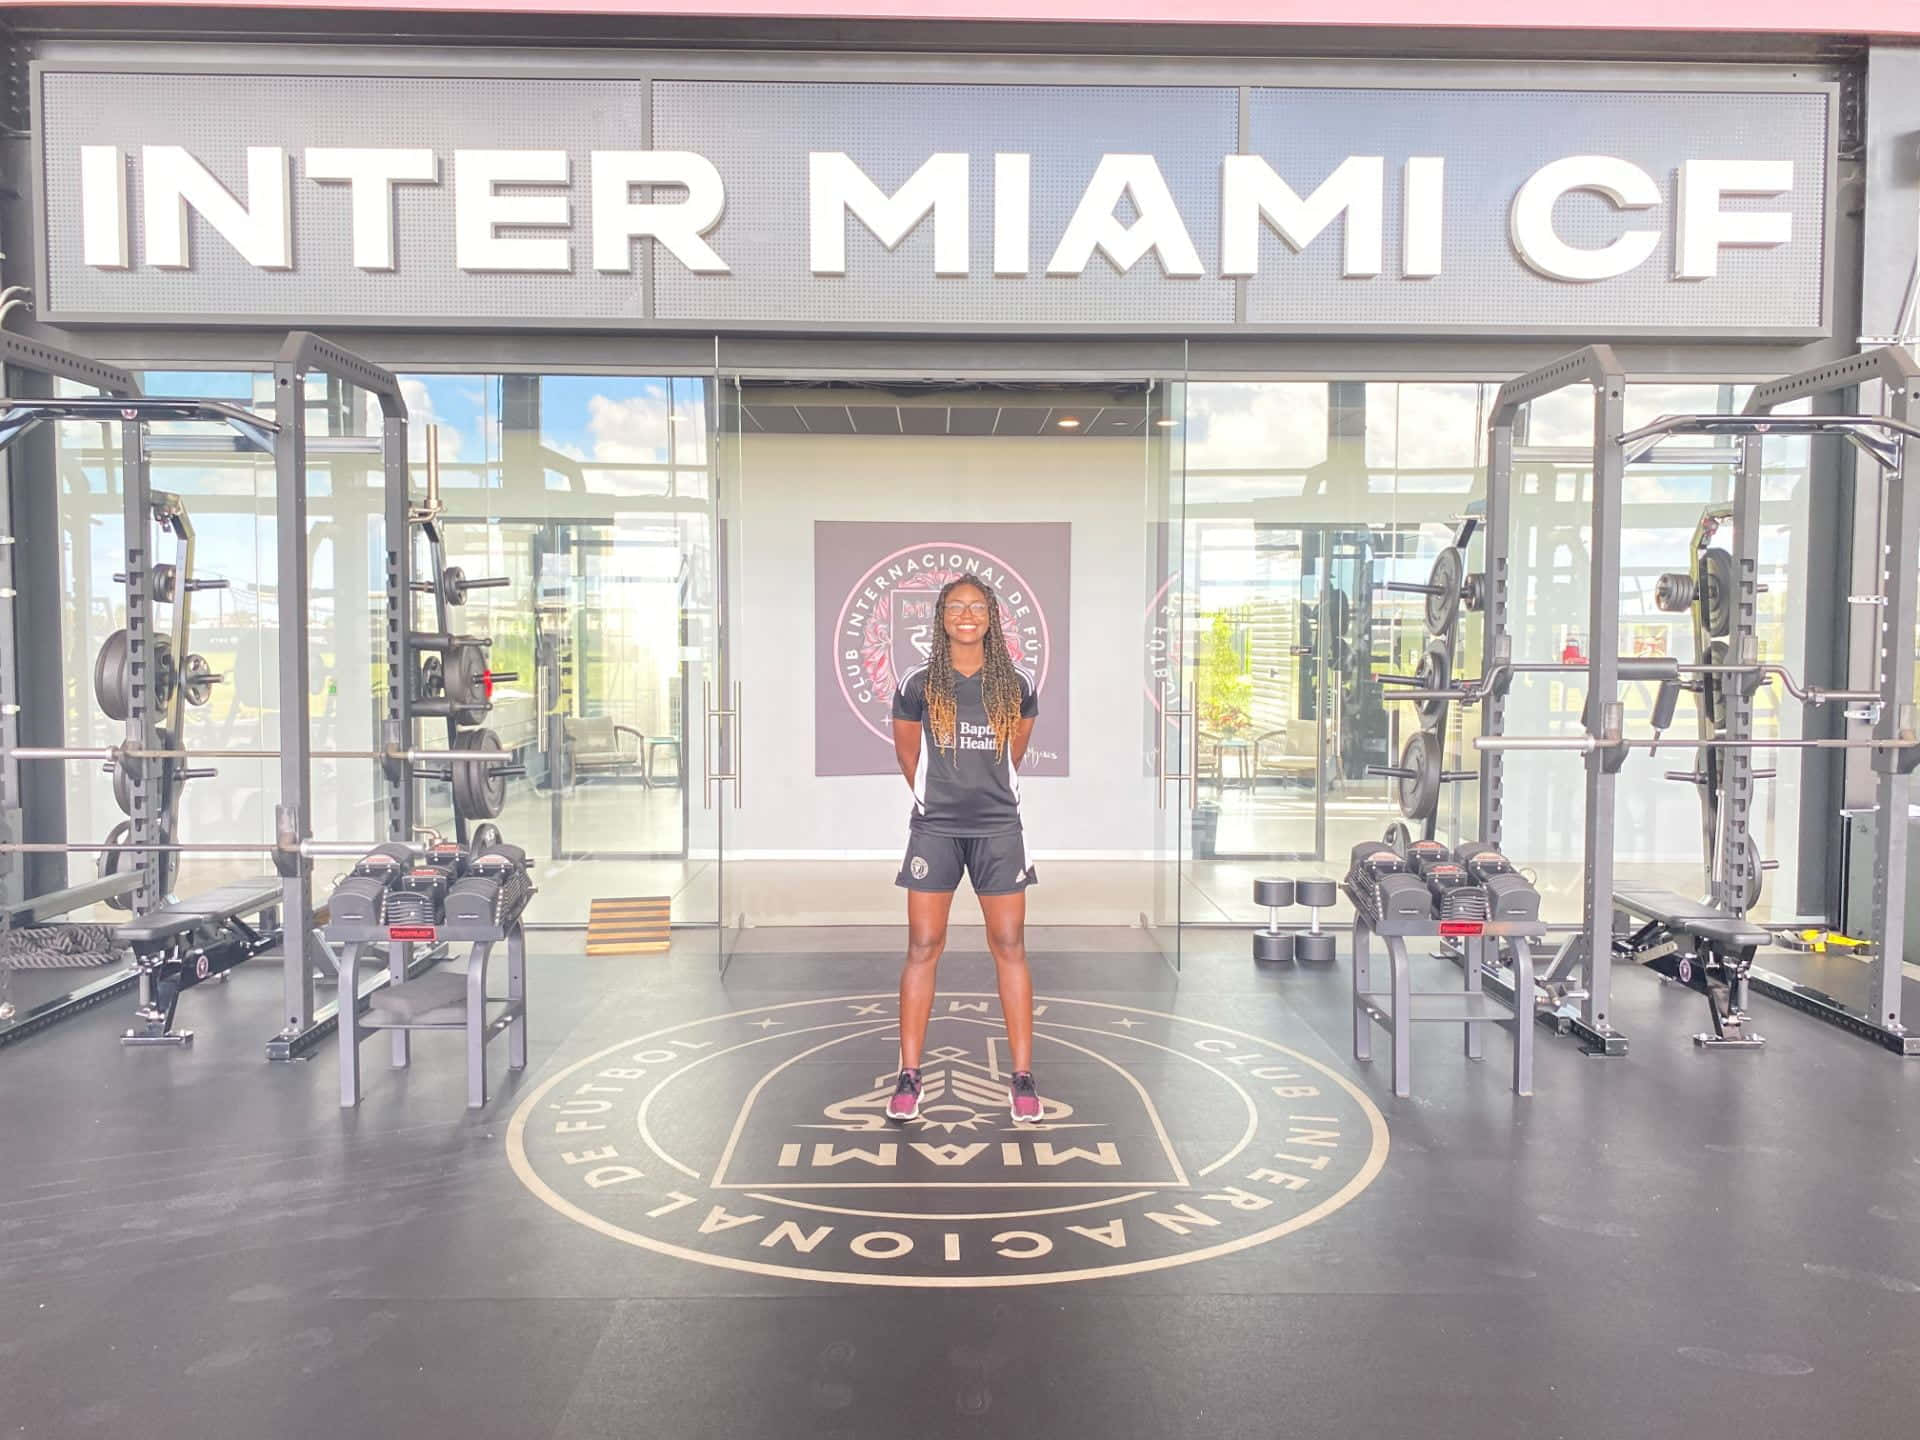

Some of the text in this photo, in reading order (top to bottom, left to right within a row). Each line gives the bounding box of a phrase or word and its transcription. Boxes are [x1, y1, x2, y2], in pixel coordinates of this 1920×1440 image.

[81, 144, 1795, 283] INTER MIAMI CF
[847, 553, 1006, 637] INTERNACIONAL
[1008, 590, 1030, 618] DE
[845, 649, 872, 704] CLUB
[549, 1038, 1341, 1261] CLUB INTERNACIONAL DE FÚTBOL
[777, 1142, 1122, 1167] MIAMI
